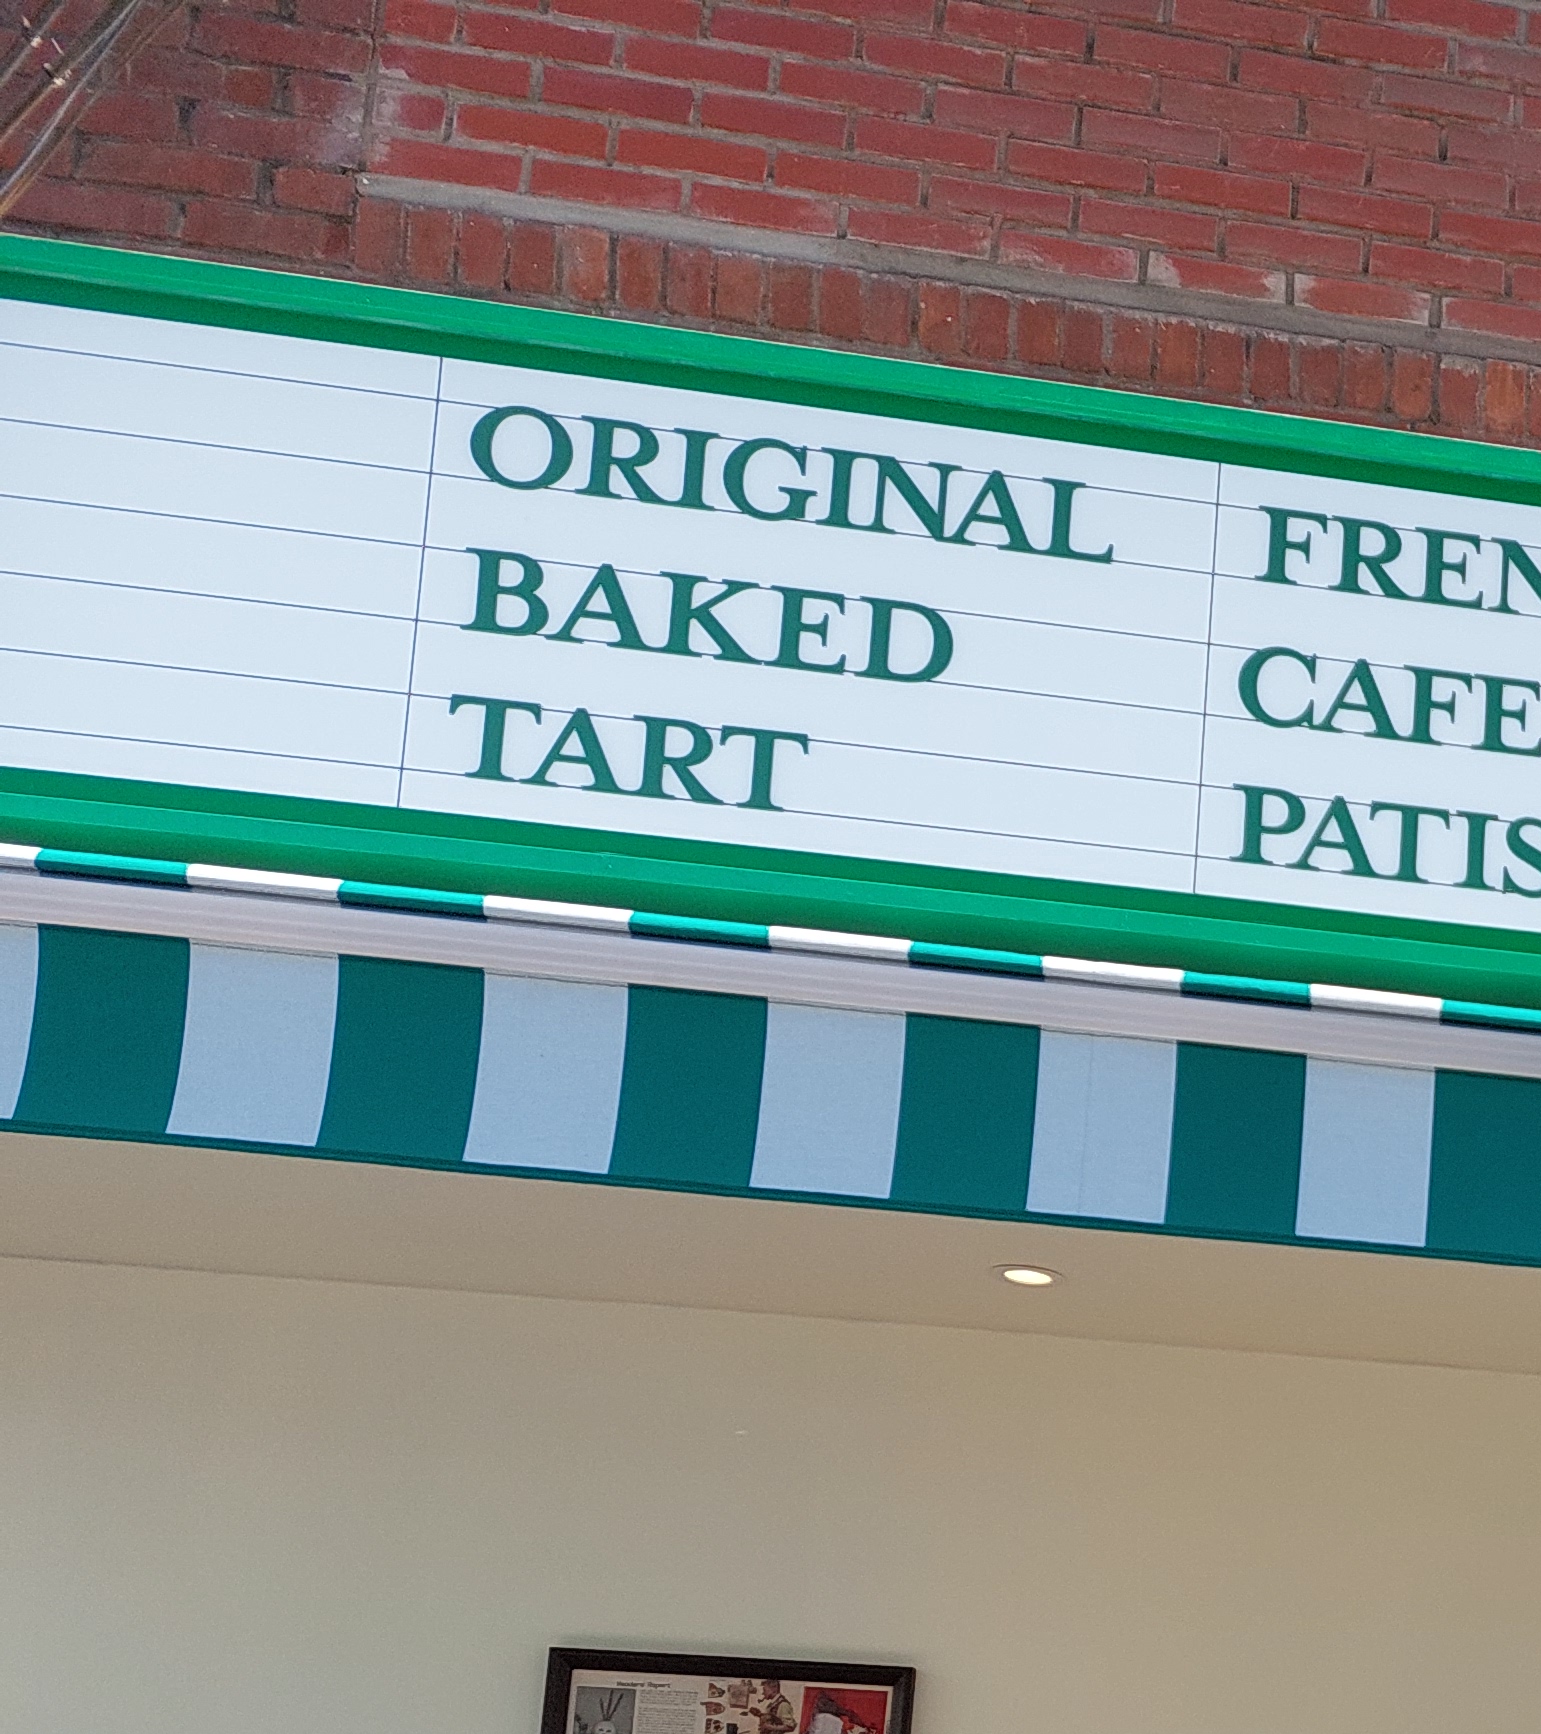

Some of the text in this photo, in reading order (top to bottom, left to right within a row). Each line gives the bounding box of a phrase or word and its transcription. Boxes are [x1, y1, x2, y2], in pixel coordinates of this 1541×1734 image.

[469, 405, 1114, 564] ORIGINAL
[459, 546, 954, 682] BAKED
[449, 693, 810, 811] TART
